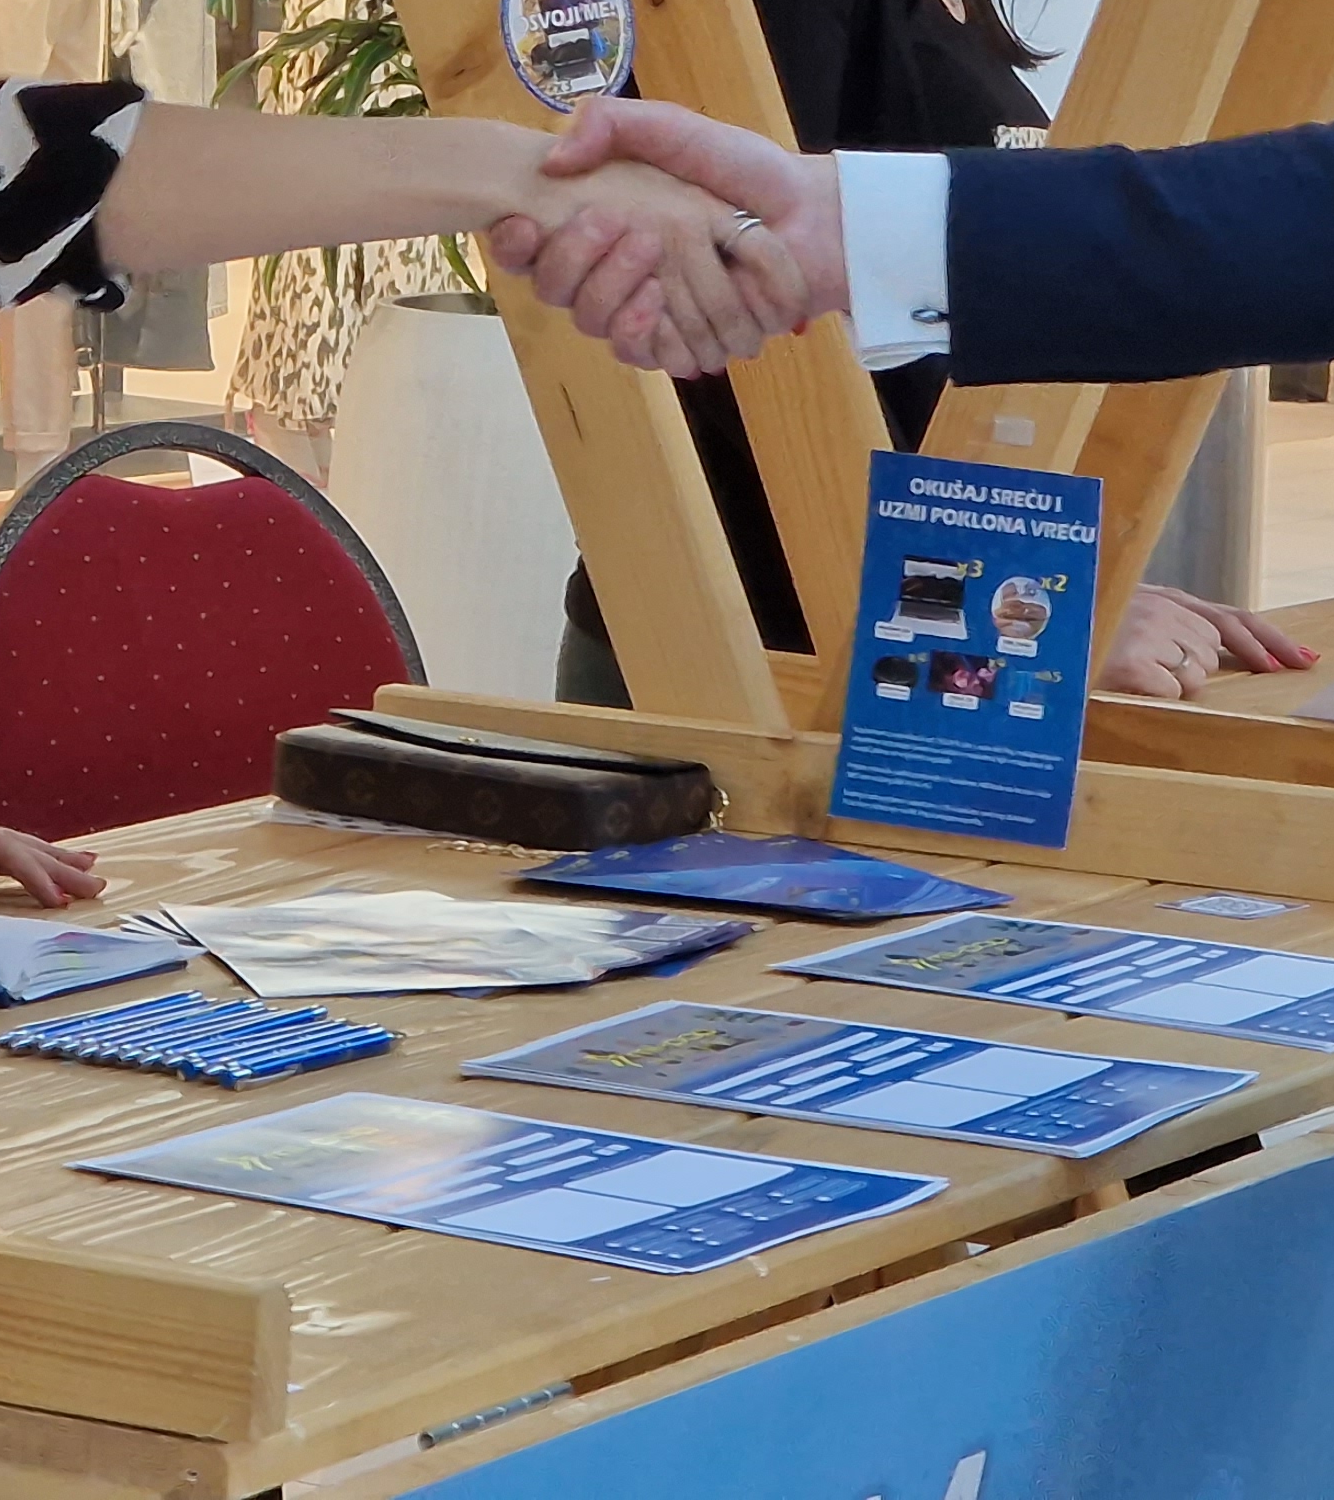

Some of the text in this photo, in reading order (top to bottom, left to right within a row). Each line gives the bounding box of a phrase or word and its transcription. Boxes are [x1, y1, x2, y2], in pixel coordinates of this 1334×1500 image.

[909, 477, 988, 503] OKUŠAJ
[878, 499, 1096, 544] UZMI POKLONA VREĆU
